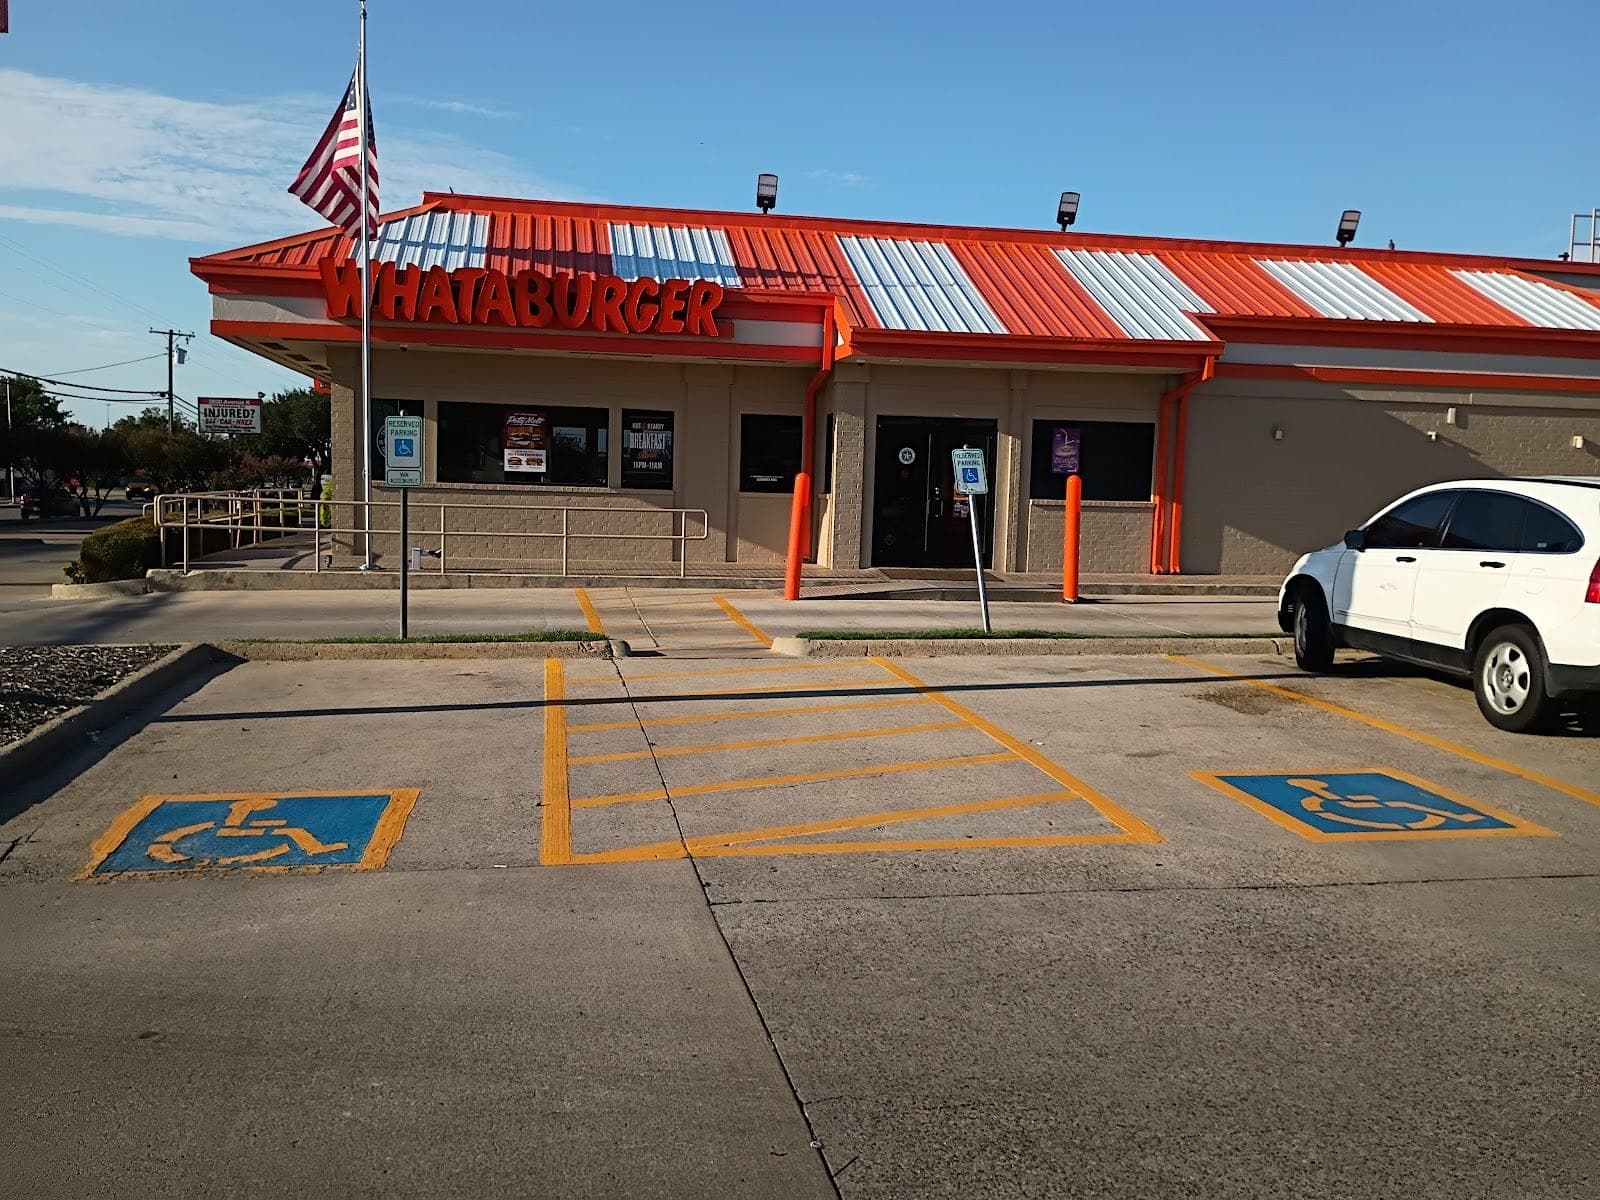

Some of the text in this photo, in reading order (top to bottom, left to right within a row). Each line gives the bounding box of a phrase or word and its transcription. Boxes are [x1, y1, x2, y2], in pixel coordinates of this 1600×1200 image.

[318, 256, 723, 336] WHATABURGER
[204, 408, 255, 418] INJURED?
[390, 429, 418, 437] PARKING
[629, 431, 666, 450] BREAKFAST
